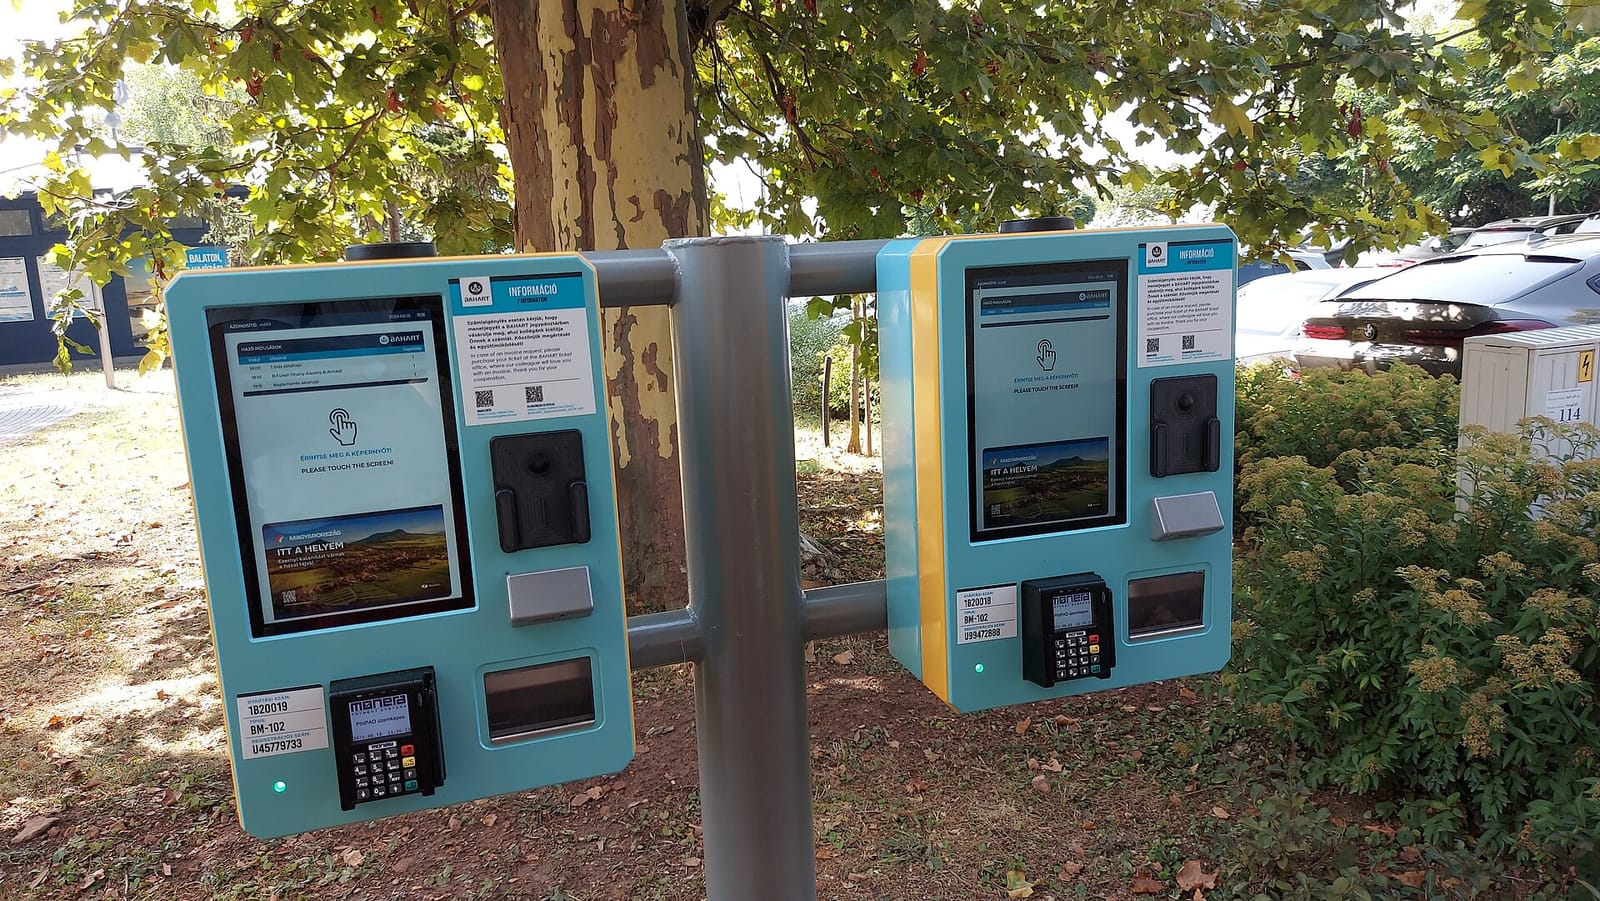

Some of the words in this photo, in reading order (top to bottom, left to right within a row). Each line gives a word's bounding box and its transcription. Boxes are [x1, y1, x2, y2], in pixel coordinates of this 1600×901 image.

[1180, 248, 1214, 260] INFORMÁCIÓ
[508, 283, 558, 297] INFORMÁCIÓ
[390, 334, 420, 343] BAHART
[1560, 407, 1580, 422] 114
[352, 448, 392, 457] KÉPERNYŐT!
[301, 466, 326, 474] PLEASE
[328, 464, 350, 472] TOUCH
[366, 460, 394, 468] SCREEN!
[1010, 464, 1038, 474] HELYEM
[277, 548, 292, 556] ITT
[294, 546, 302, 554] A
[304, 541, 344, 553] HELYEM
[964, 613, 988, 624] BM-102
[248, 702, 288, 716] 1B20019
[250, 722, 285, 736] BM-102
[252, 738, 302, 754] U45779733
